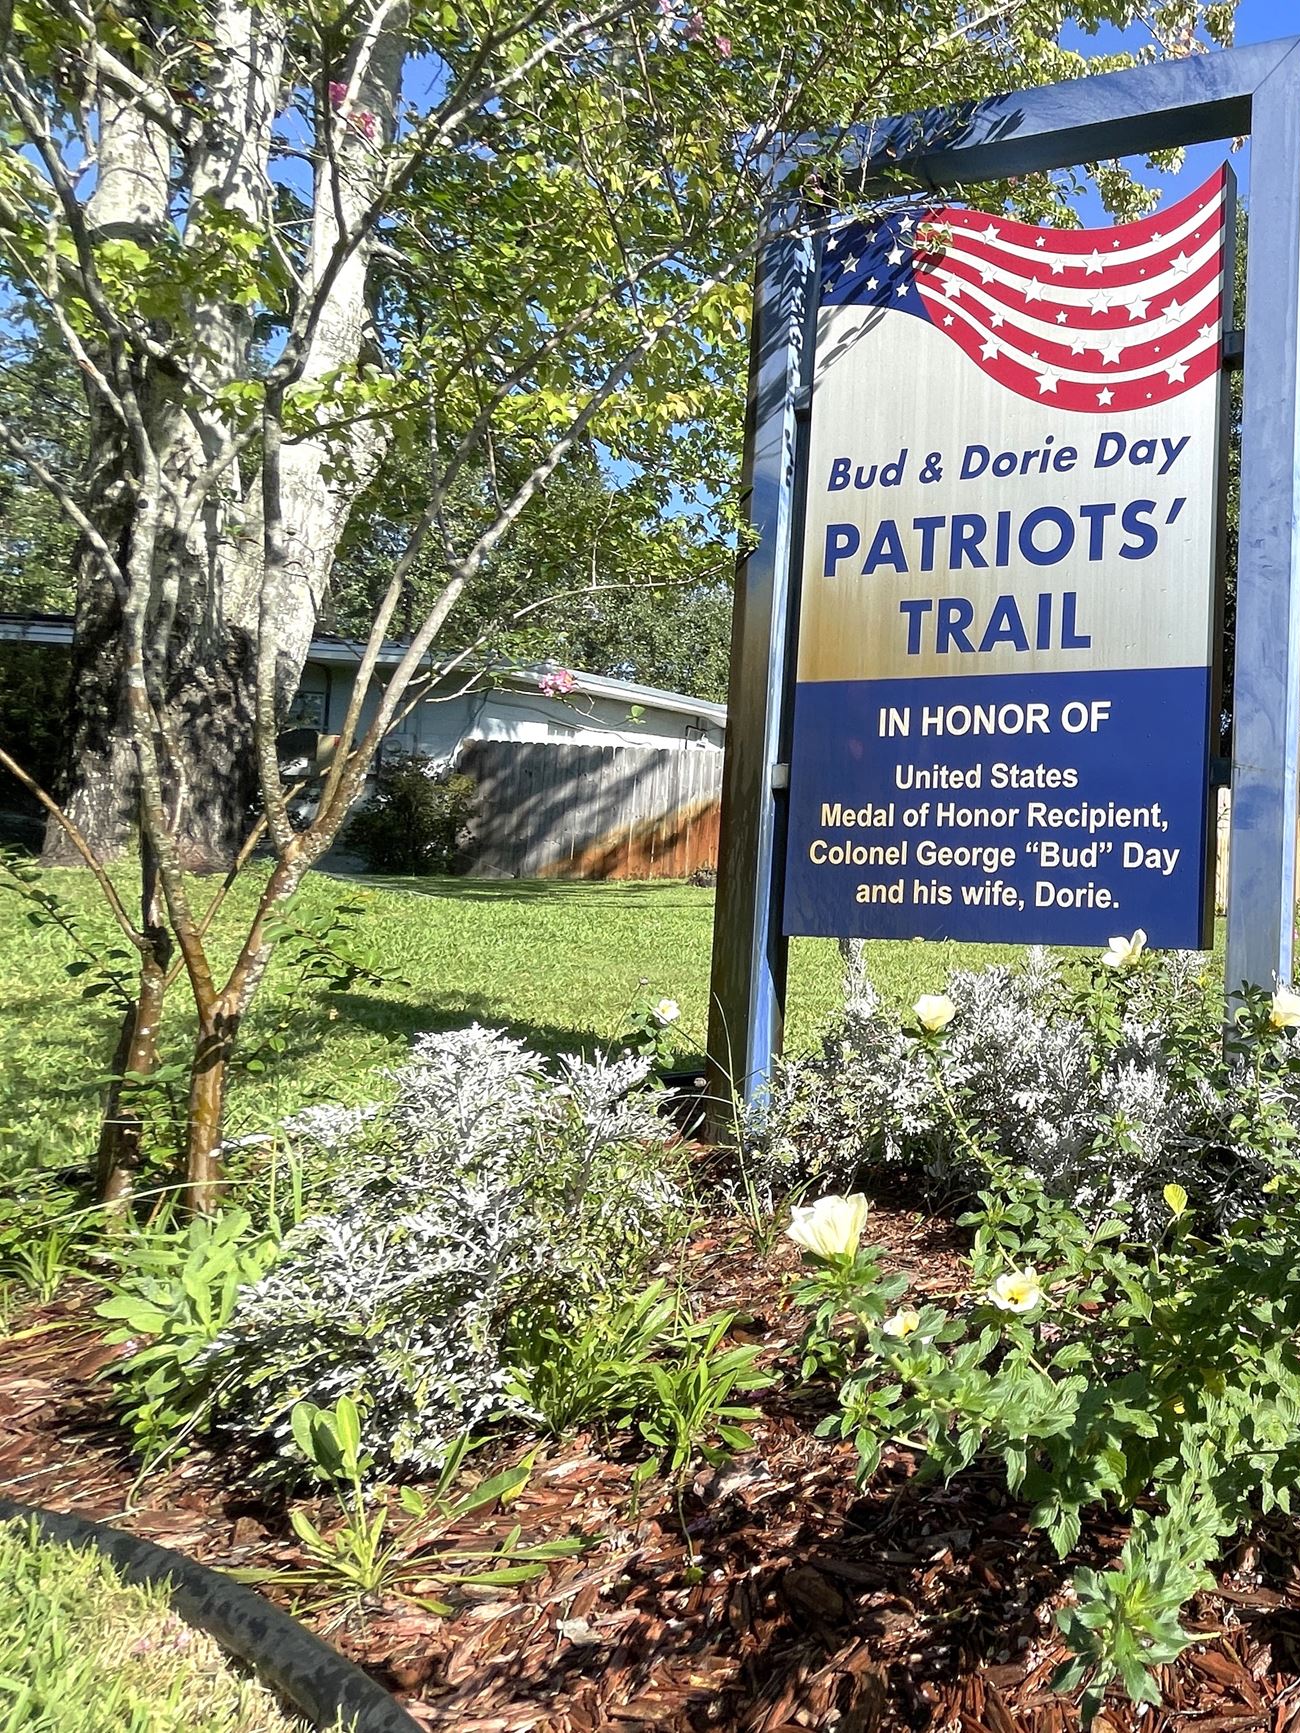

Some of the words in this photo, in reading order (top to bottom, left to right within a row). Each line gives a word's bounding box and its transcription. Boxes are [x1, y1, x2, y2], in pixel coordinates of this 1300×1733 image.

[827, 448, 908, 492] Bud
[919, 452, 943, 484] &
[959, 435, 1077, 480] Dorie
[1094, 431, 1191, 475] Day
[900, 591, 1091, 655] TRAIL
[878, 707, 910, 737] IN
[921, 703, 1051, 736] HONOR
[1061, 701, 1112, 733] OF
[895, 764, 982, 790] United
[990, 762, 1078, 788] States
[820, 803, 894, 828] Medal
[902, 802, 930, 827] of
[936, 803, 1019, 828] Honor
[1027, 802, 1169, 833] Recipient,
[809, 840, 907, 865] Colonel
[916, 841, 1016, 872] George
[1122, 842, 1180, 875] Day
[856, 879, 904, 904] and
[913, 879, 952, 905] his
[961, 880, 1025, 910] wife,
[1035, 881, 1119, 908] Dorie.
